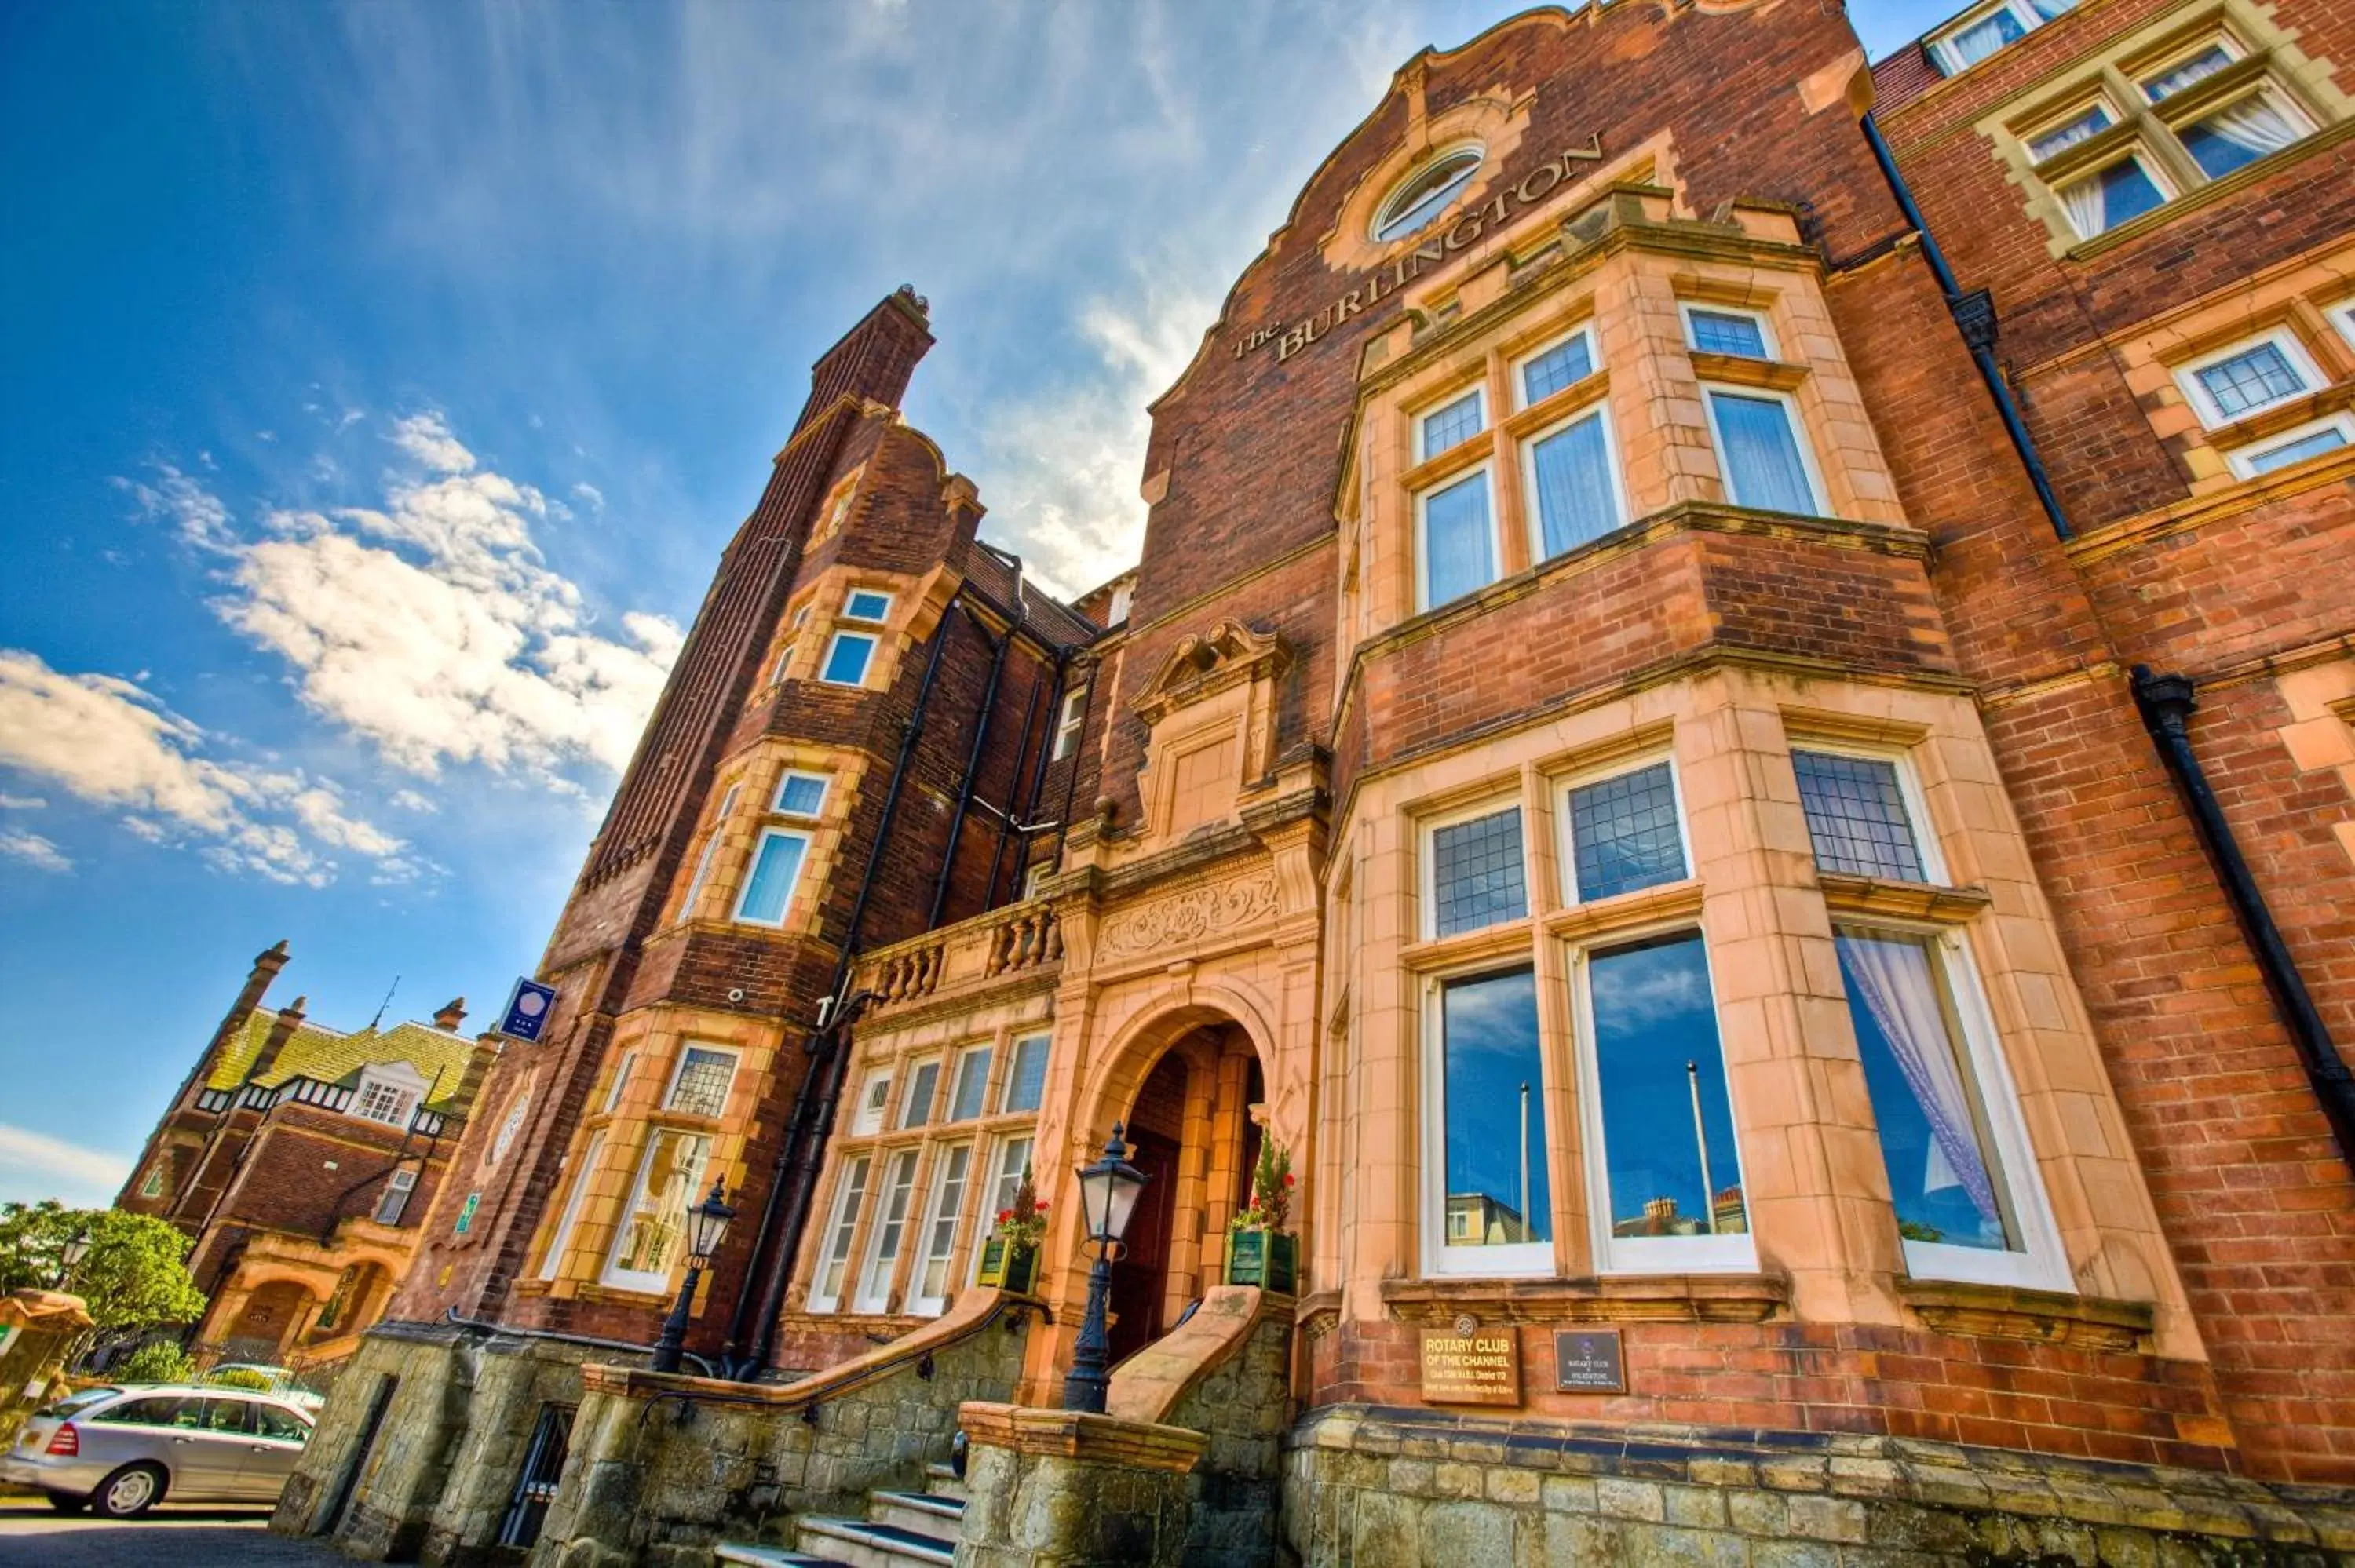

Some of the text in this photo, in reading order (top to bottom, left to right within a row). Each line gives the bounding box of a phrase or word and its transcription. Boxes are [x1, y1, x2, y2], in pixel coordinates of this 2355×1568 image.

[1278, 130, 1605, 362] BURLINGTON
[1426, 1338, 1510, 1353] ROTARY CLUB
[1426, 1355, 1510, 1367] OF THE CHANNEL
